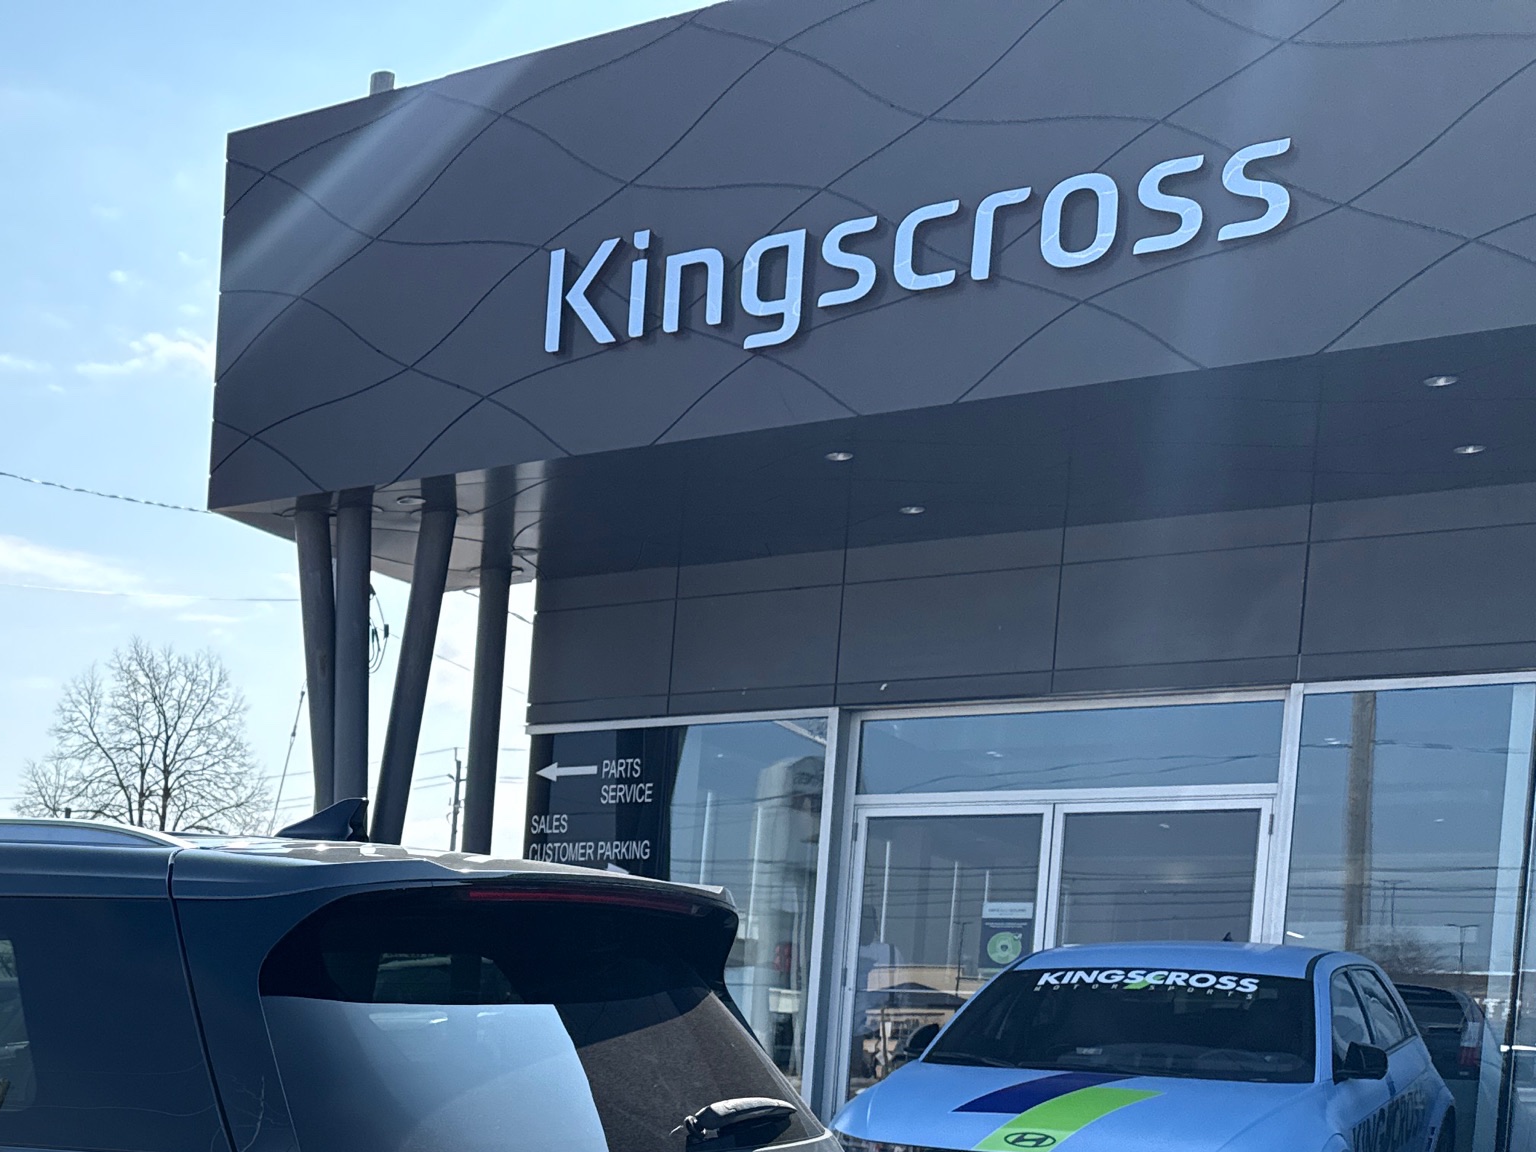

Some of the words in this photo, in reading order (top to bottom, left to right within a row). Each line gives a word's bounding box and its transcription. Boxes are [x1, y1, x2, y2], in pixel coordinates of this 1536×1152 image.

[543, 136, 1293, 354] Kingscross
[601, 758, 642, 780] PARTS
[600, 782, 654, 805] SERVICE
[530, 814, 568, 834] SALES
[528, 842, 595, 863] CUSTOMER
[596, 839, 651, 861] PARKING
[1036, 969, 1260, 994] KINGSCROSS
